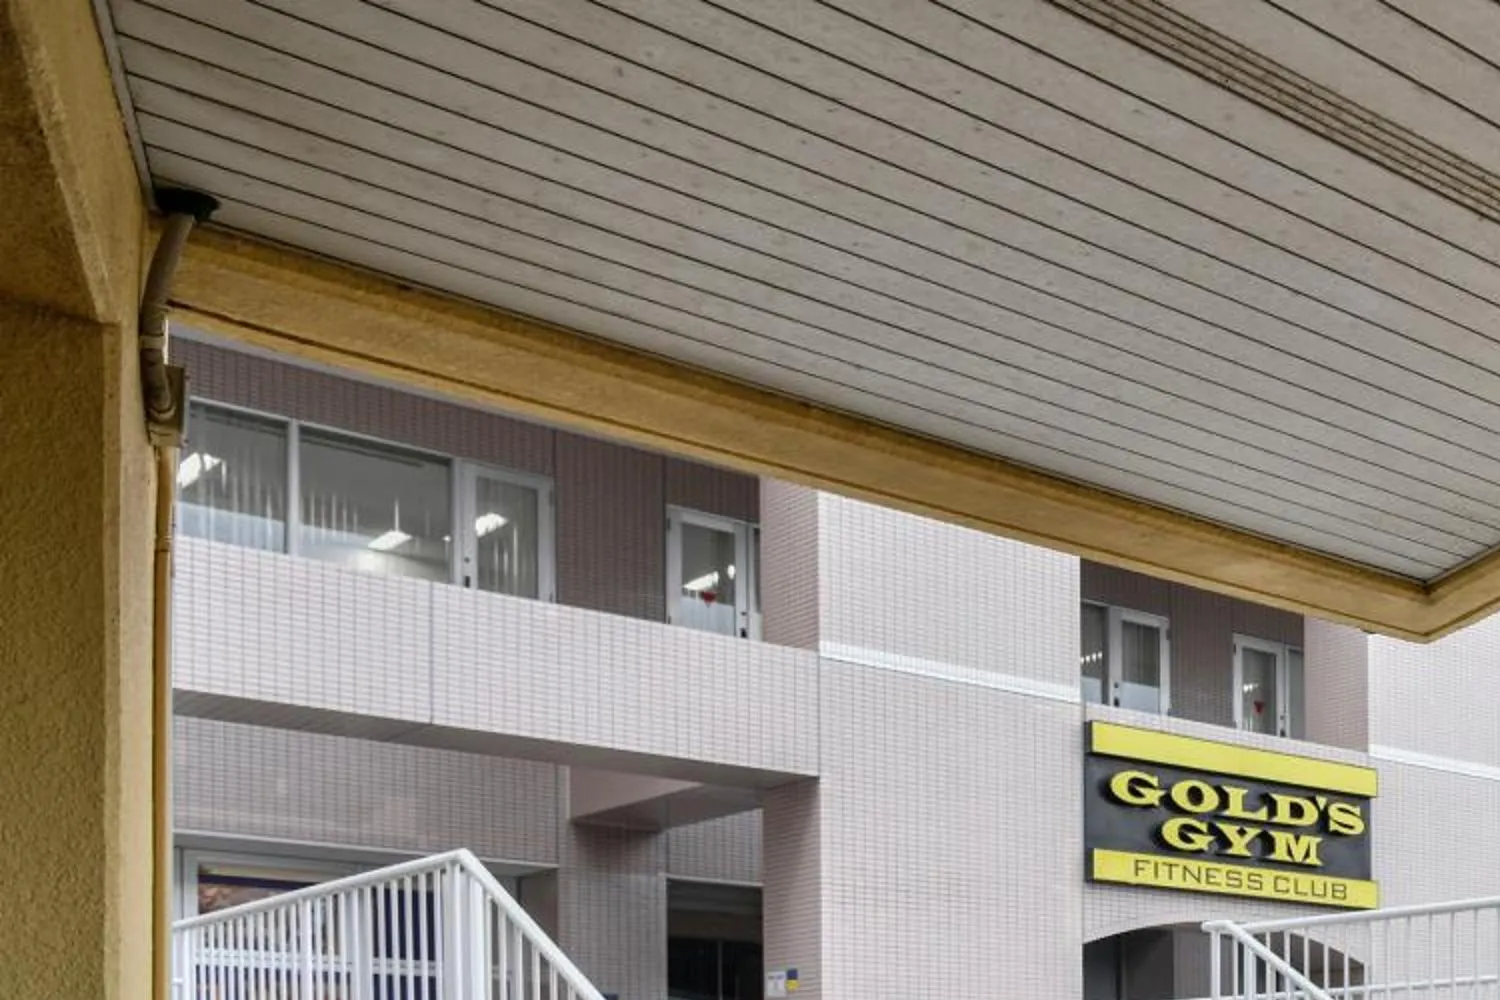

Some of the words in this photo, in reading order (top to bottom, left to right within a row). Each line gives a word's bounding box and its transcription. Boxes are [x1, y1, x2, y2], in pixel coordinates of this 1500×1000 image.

[1109, 769, 1365, 836] GOLD'S
[1160, 816, 1323, 867] GYM
[1133, 858, 1264, 891] FITNESS
[1273, 874, 1348, 901] CLUB
